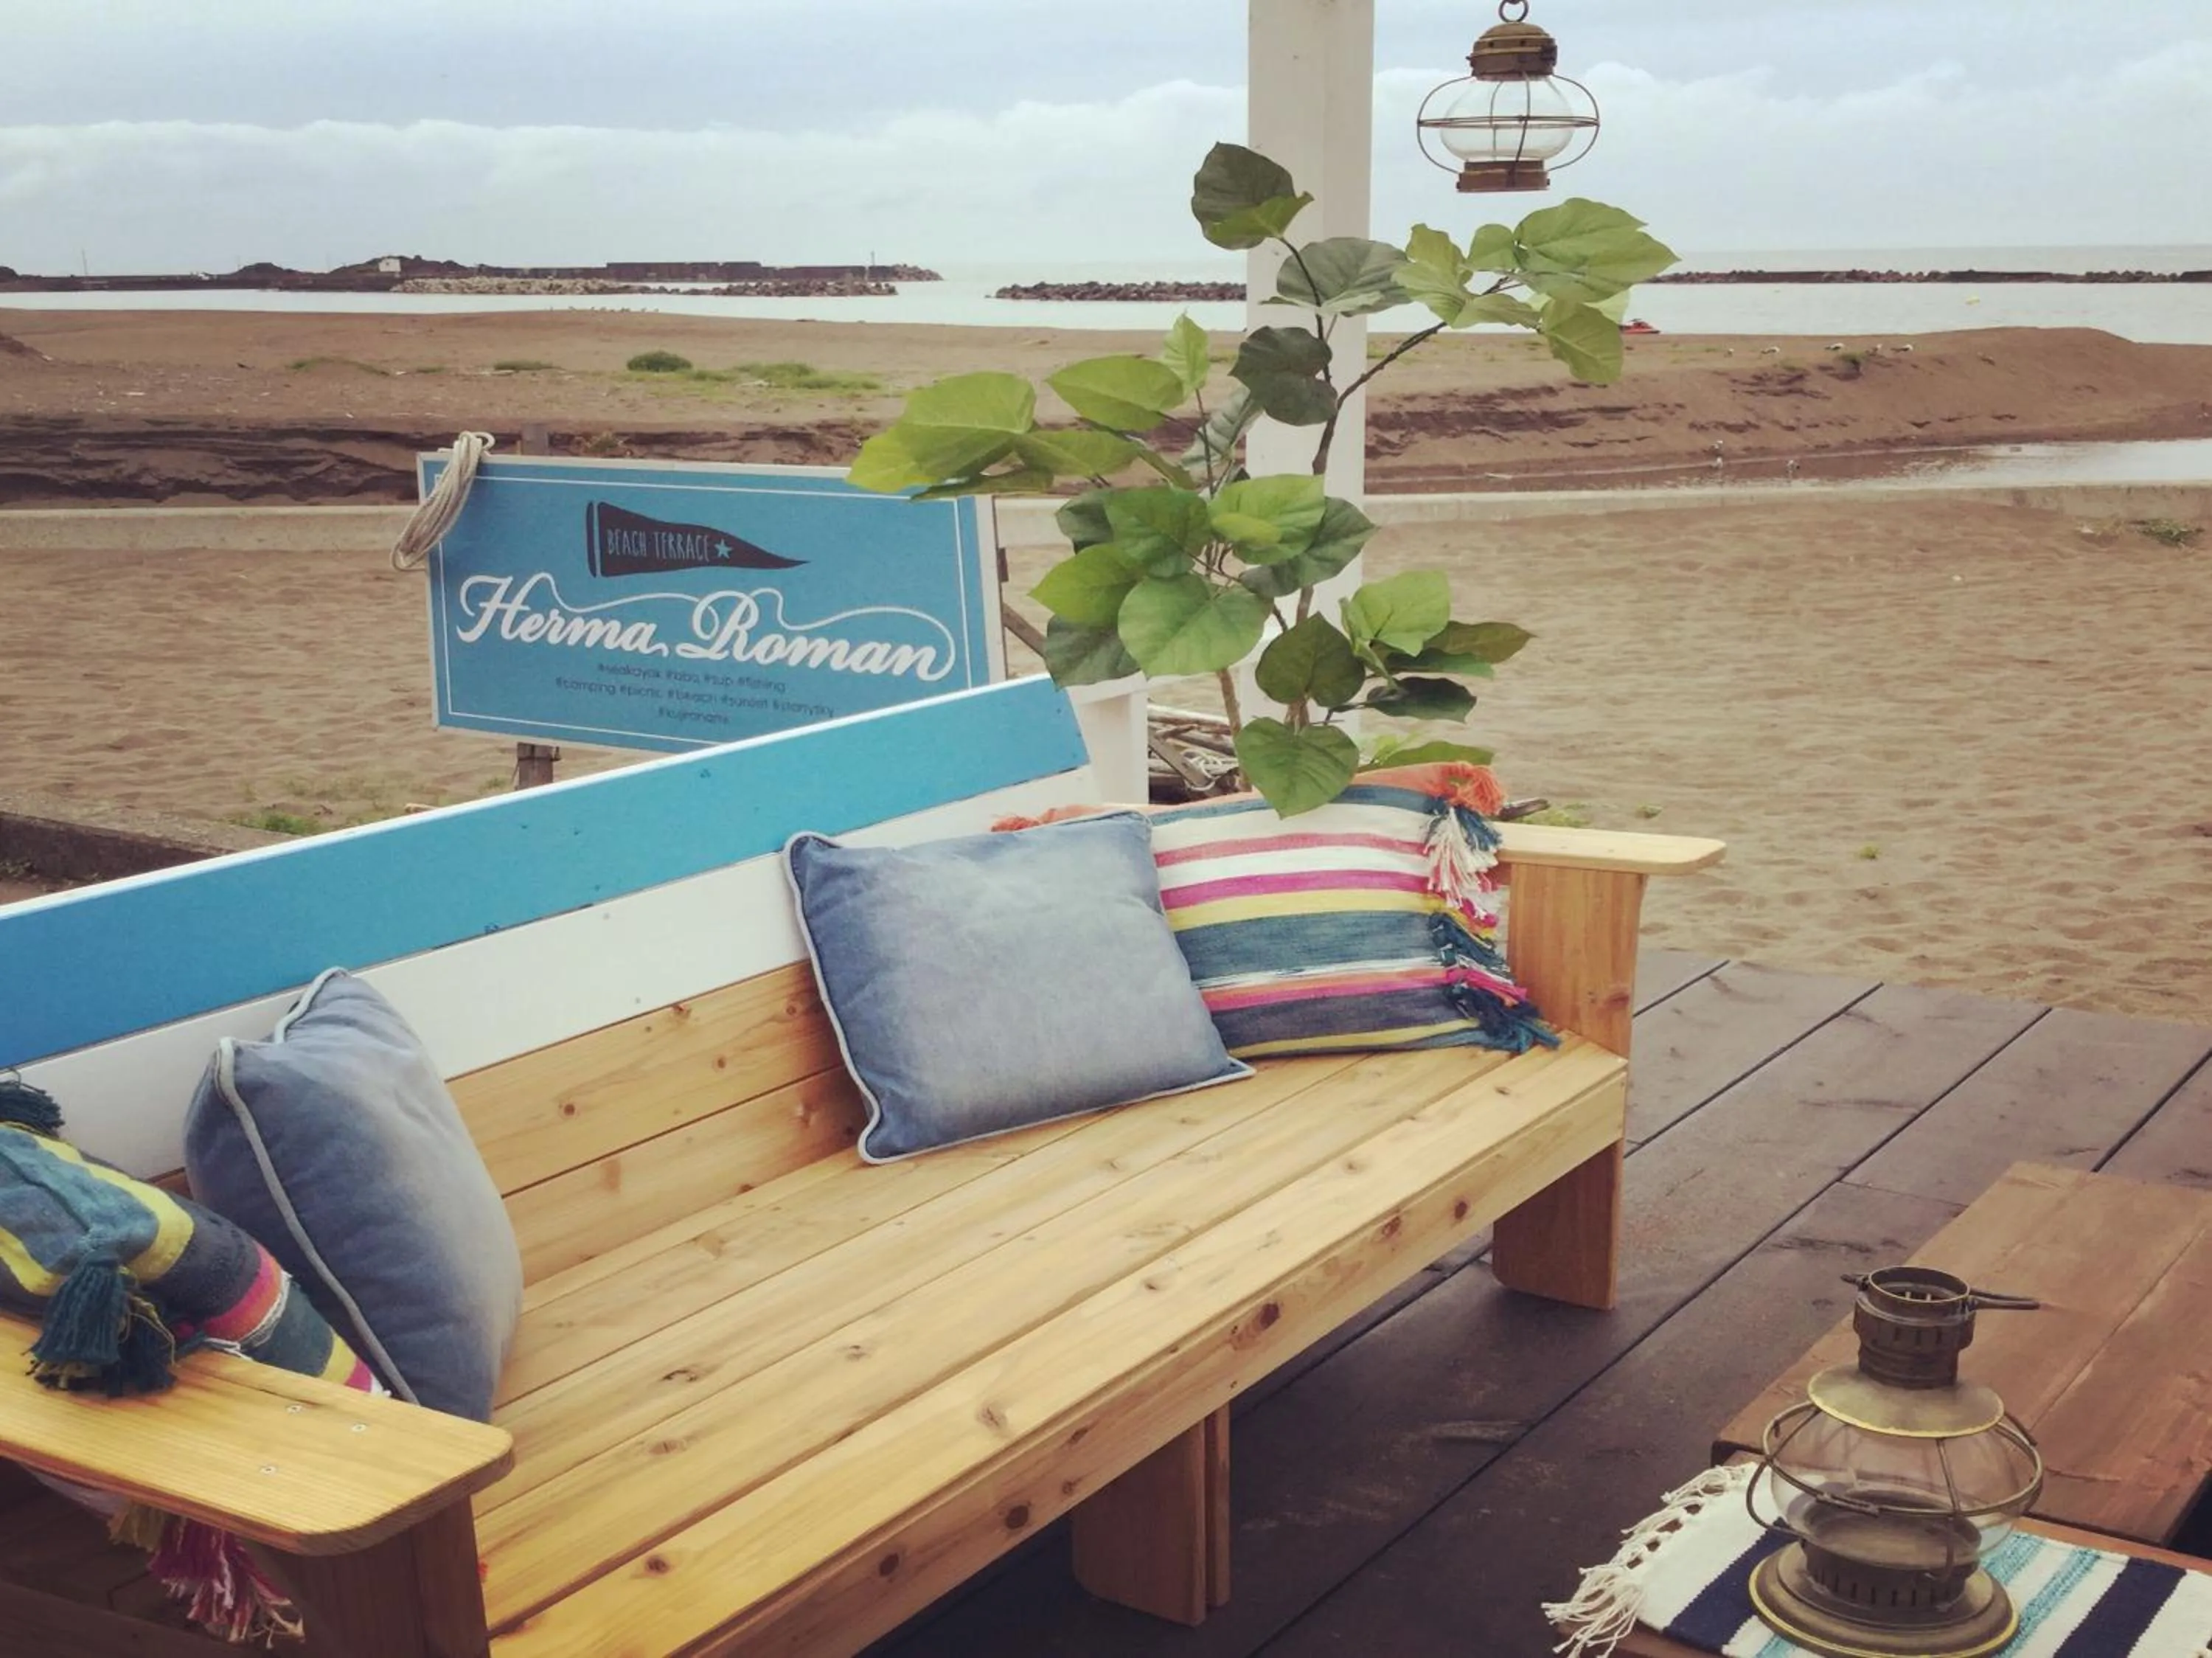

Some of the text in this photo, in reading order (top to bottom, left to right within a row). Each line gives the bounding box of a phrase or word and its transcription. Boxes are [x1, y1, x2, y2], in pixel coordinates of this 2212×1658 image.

[607, 529, 709, 562] BEACH TERRACE
[456, 572, 954, 681] Herma Roman
